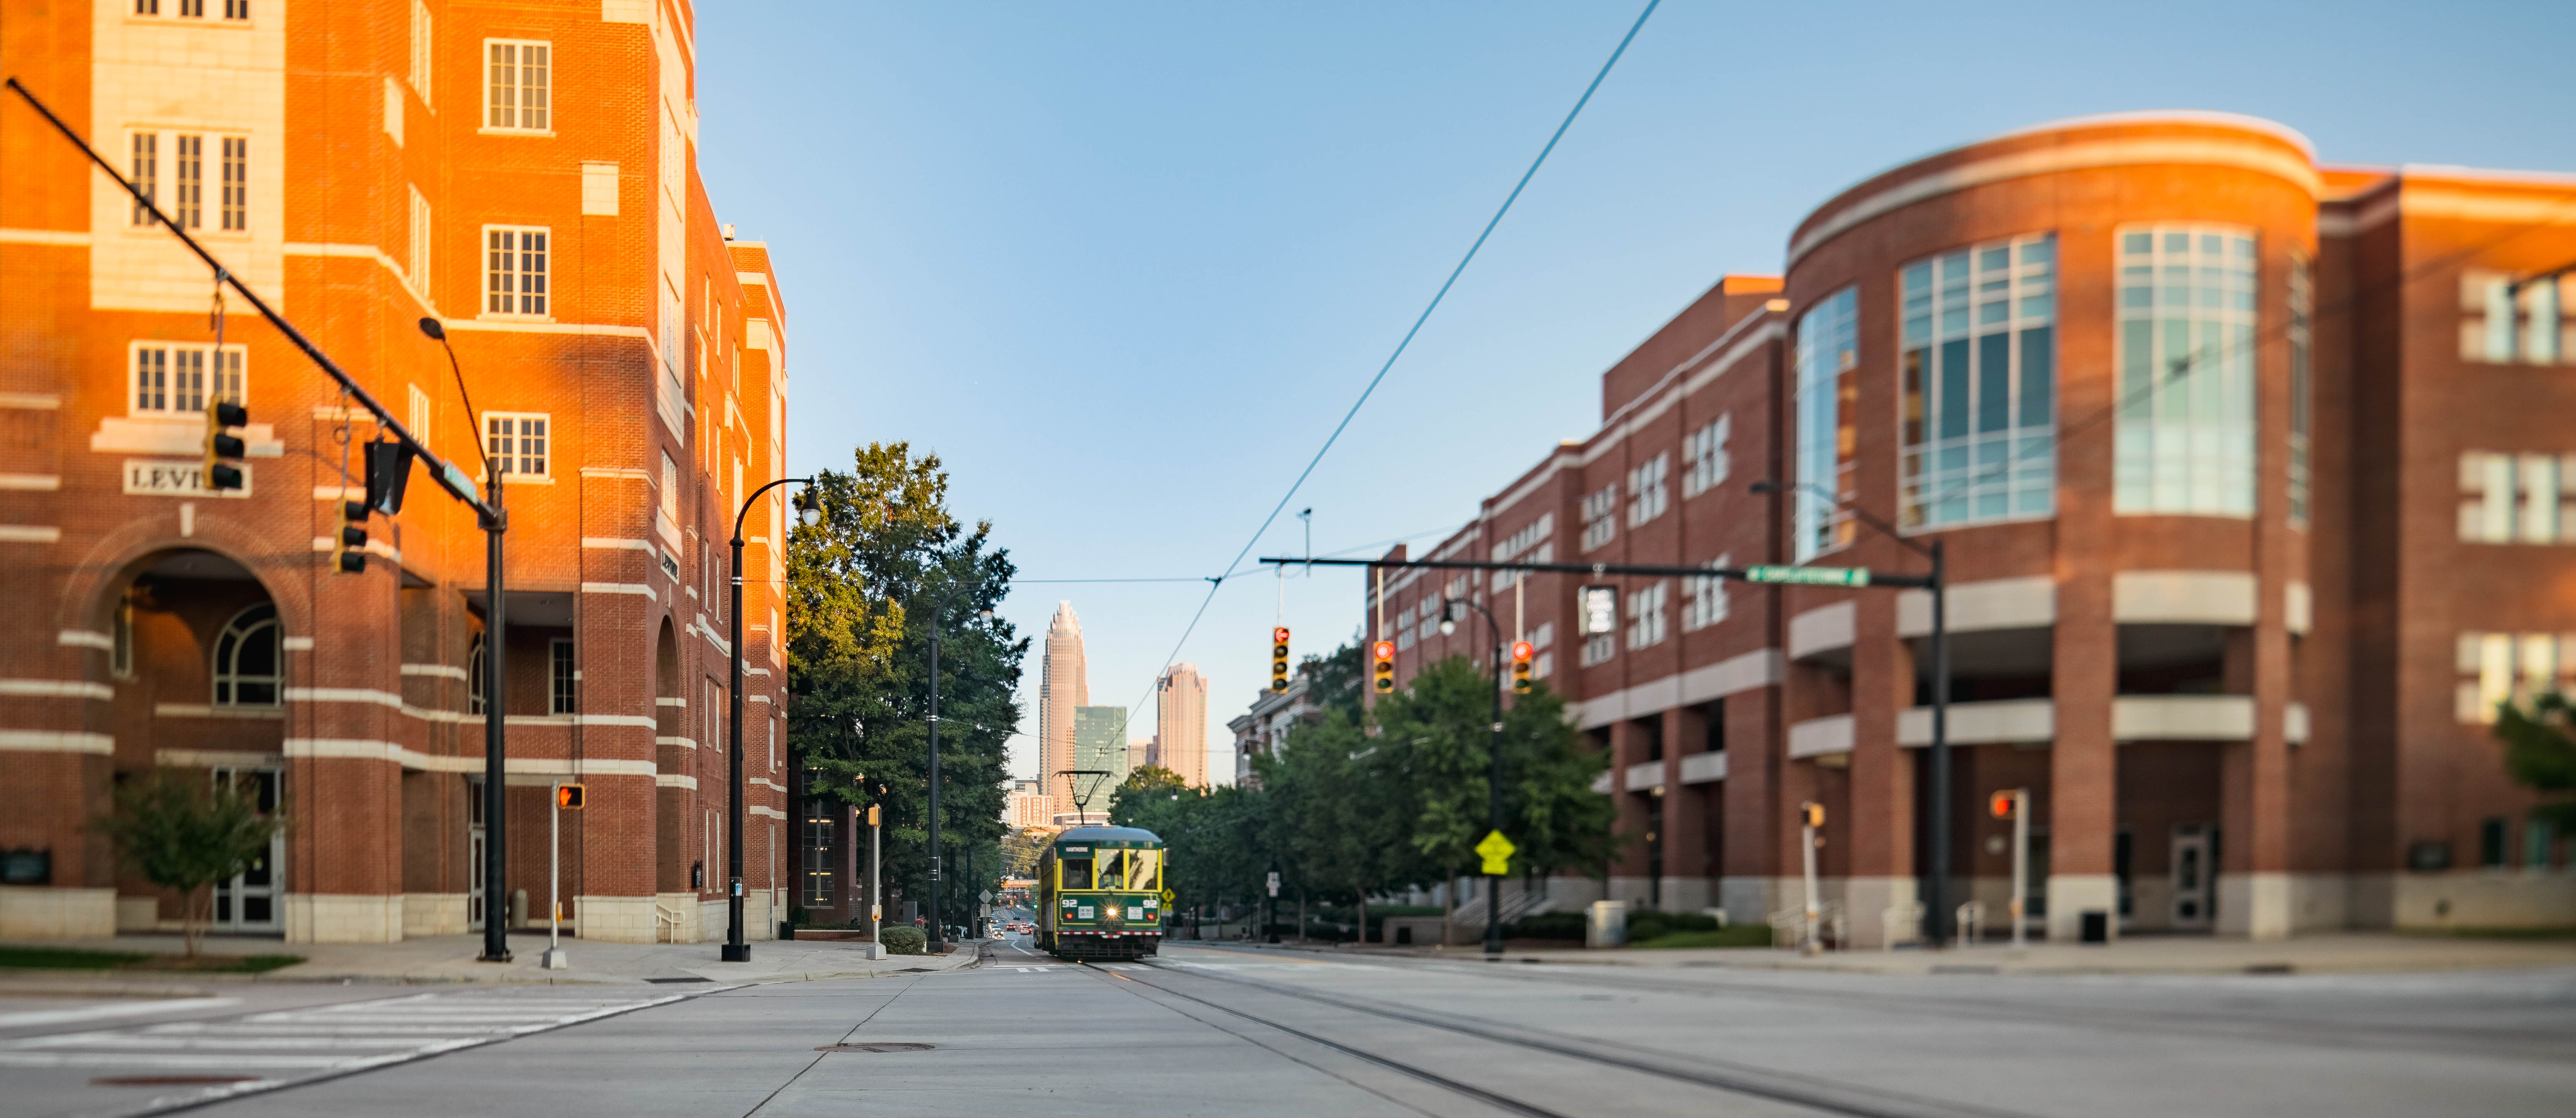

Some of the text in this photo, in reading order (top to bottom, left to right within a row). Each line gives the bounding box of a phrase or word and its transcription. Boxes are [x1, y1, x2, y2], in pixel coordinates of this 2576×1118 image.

[133, 468, 201, 489] LEVI
[1062, 899, 1078, 908] 92
[1143, 899, 1157, 909] 92
